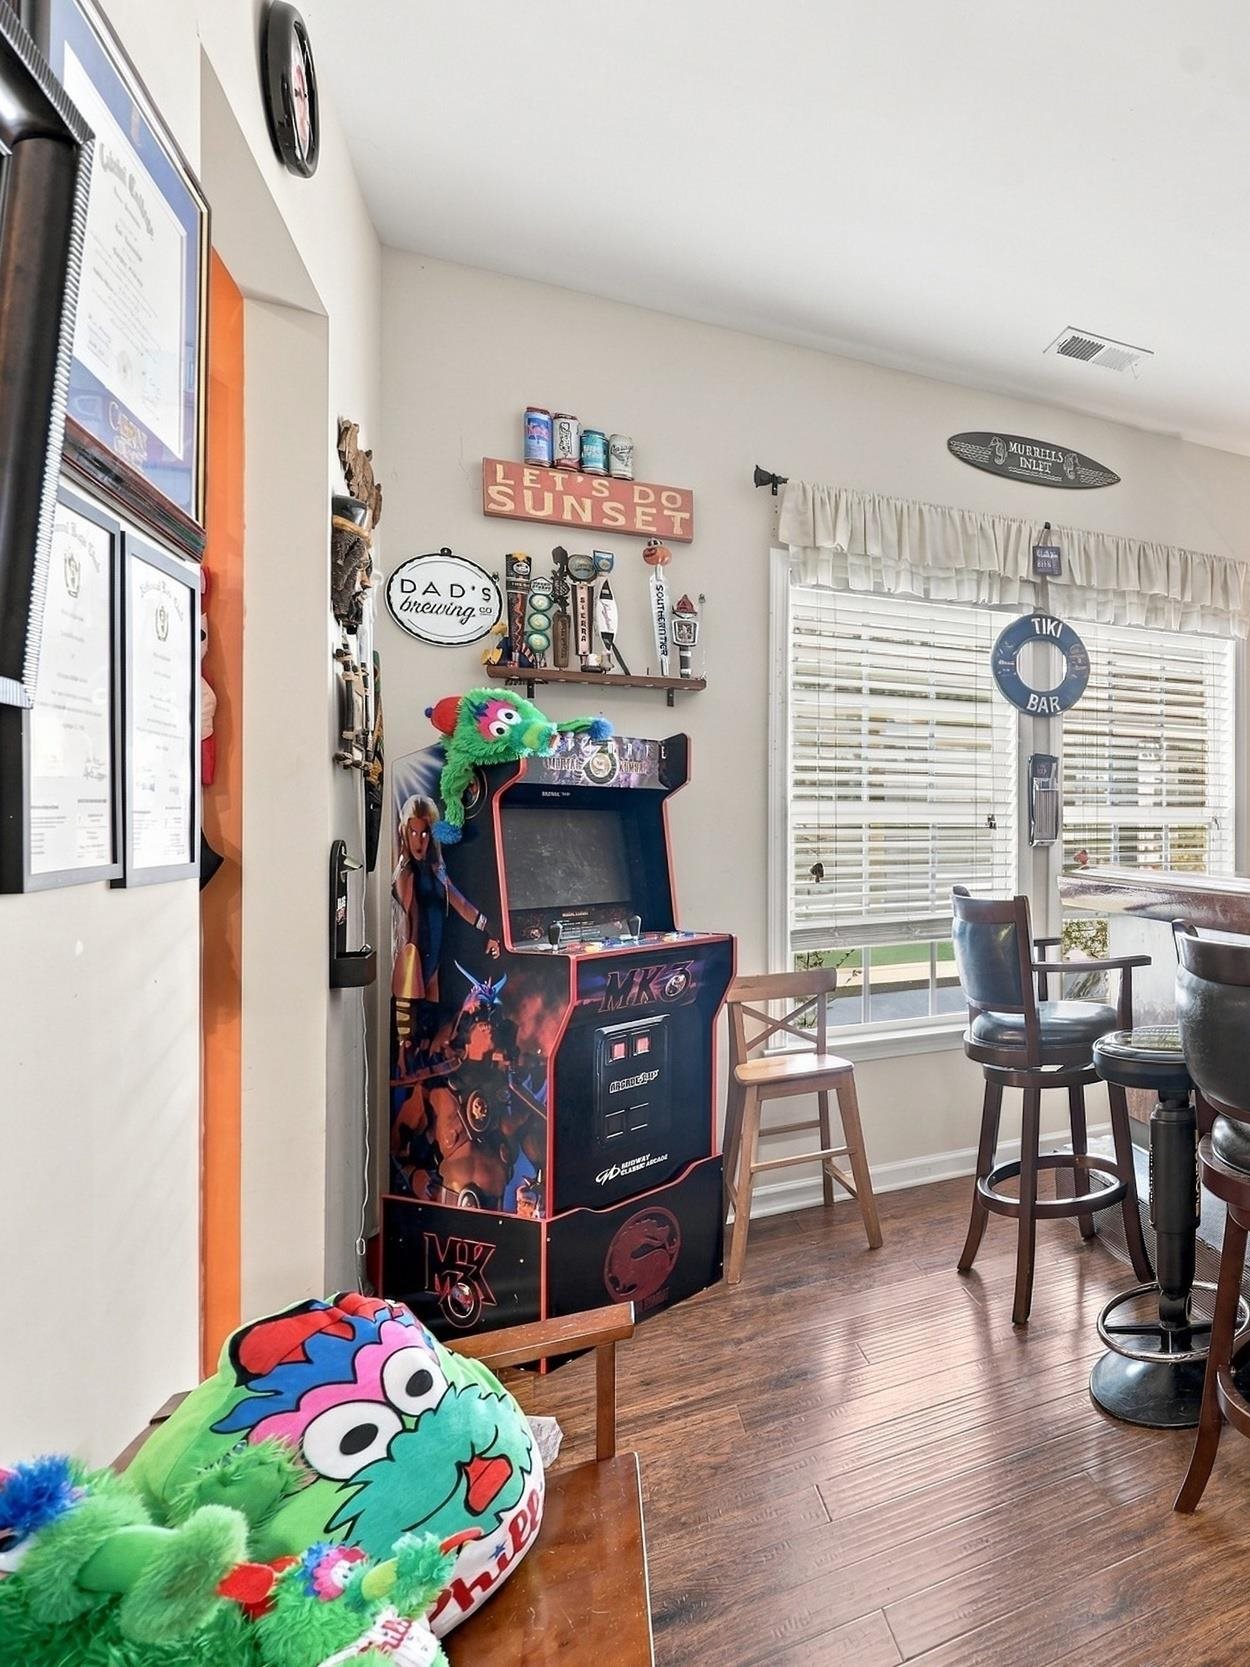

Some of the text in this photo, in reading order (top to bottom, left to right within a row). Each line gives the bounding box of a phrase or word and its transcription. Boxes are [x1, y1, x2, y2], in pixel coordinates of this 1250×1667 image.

[1008, 441, 1064, 463] MURRELLS
[1020, 456, 1052, 474] INLET
[495, 463, 682, 509] LET'S DO
[487, 485, 690, 535] SUNSET
[400, 578, 492, 601] DAD'S
[400, 596, 476, 625] brewing
[1031, 617, 1063, 638] TIKI
[1026, 693, 1061, 714] BAR
[620, 1154, 668, 1176] CLASSIC ARCADE
[621, 1153, 651, 1169] MIDWAY
